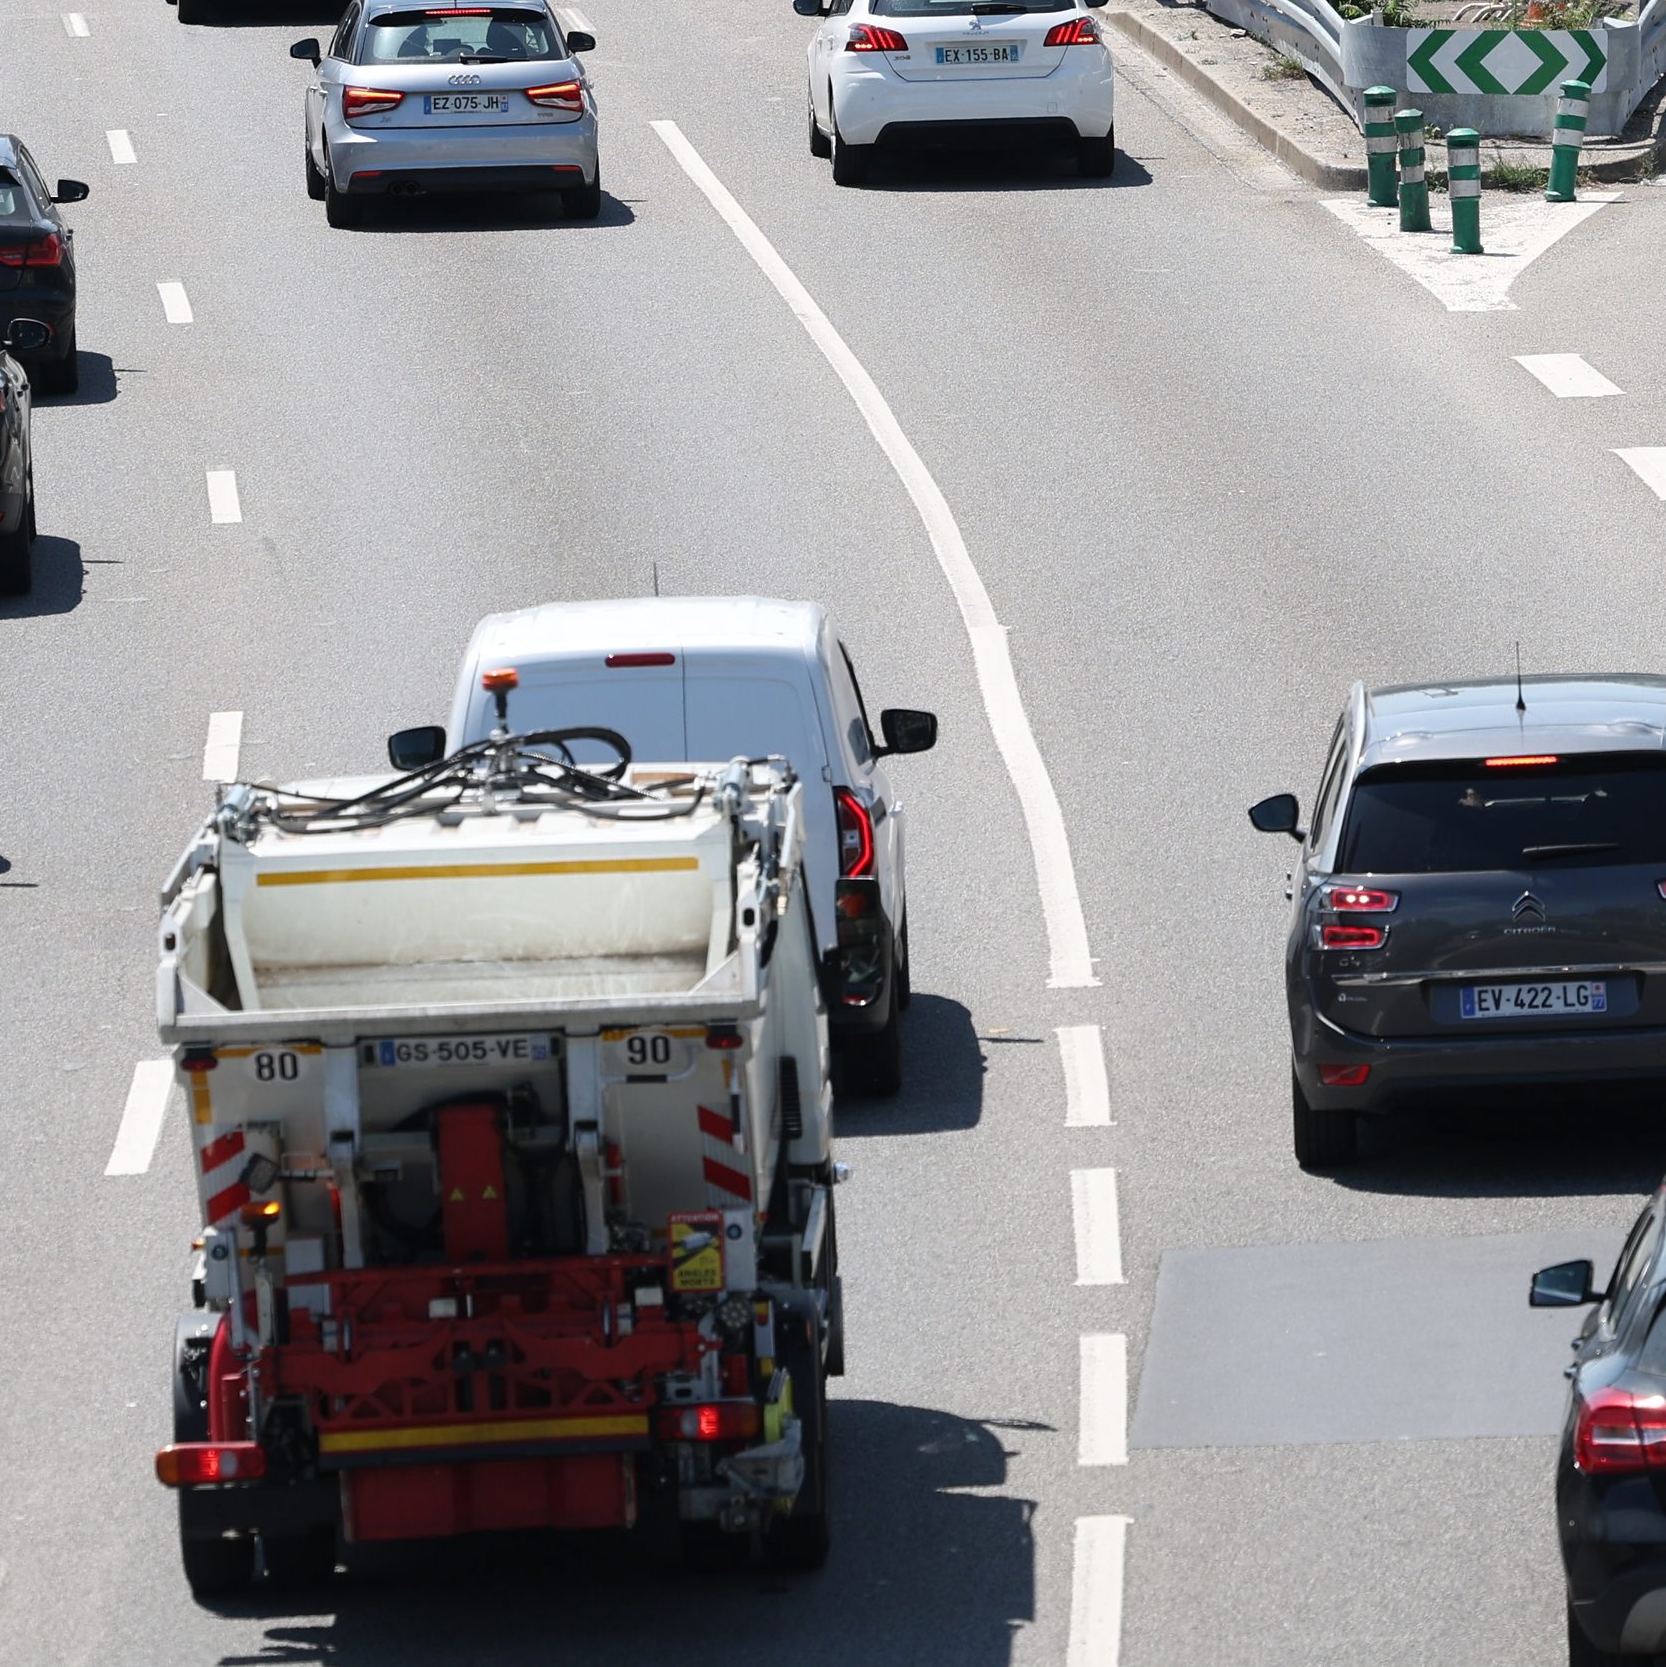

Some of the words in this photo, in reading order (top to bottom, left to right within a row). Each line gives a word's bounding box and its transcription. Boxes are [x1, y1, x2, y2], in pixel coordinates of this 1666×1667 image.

[944, 46, 1009, 63] EX-155-BA
[433, 94, 500, 110] EZ-075-JH
[1477, 985, 1590, 1013] EV-422-LG
[396, 1039, 529, 1064] GS-505-VE
[627, 1036, 672, 1065] 90
[255, 1052, 299, 1082] 80
